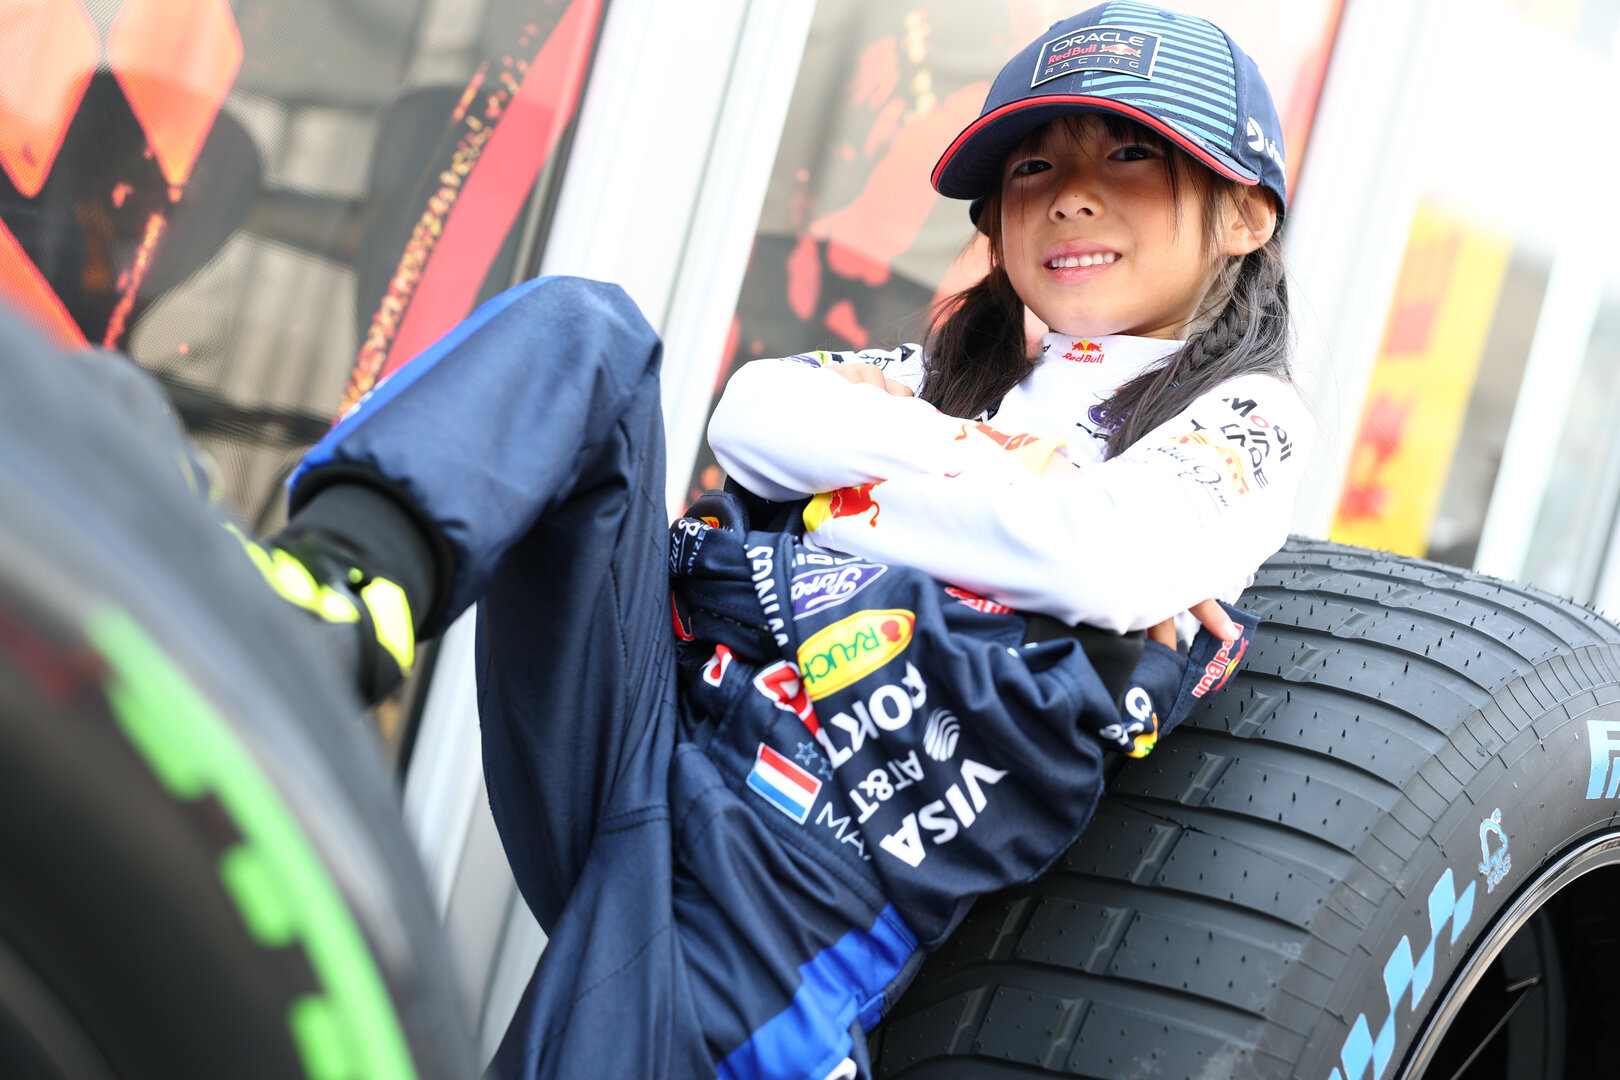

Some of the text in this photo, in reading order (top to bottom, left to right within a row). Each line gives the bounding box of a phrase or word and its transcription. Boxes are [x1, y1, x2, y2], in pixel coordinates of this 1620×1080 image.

[1052, 32, 1146, 53] ORACLE
[1047, 44, 1098, 65] Red Bull
[1045, 57, 1140, 75] RACING
[1062, 352, 1105, 364] Red Bull
[1191, 661, 1226, 698] Bull
[849, 750, 925, 824] AT&T
[879, 759, 1009, 868] VISA
